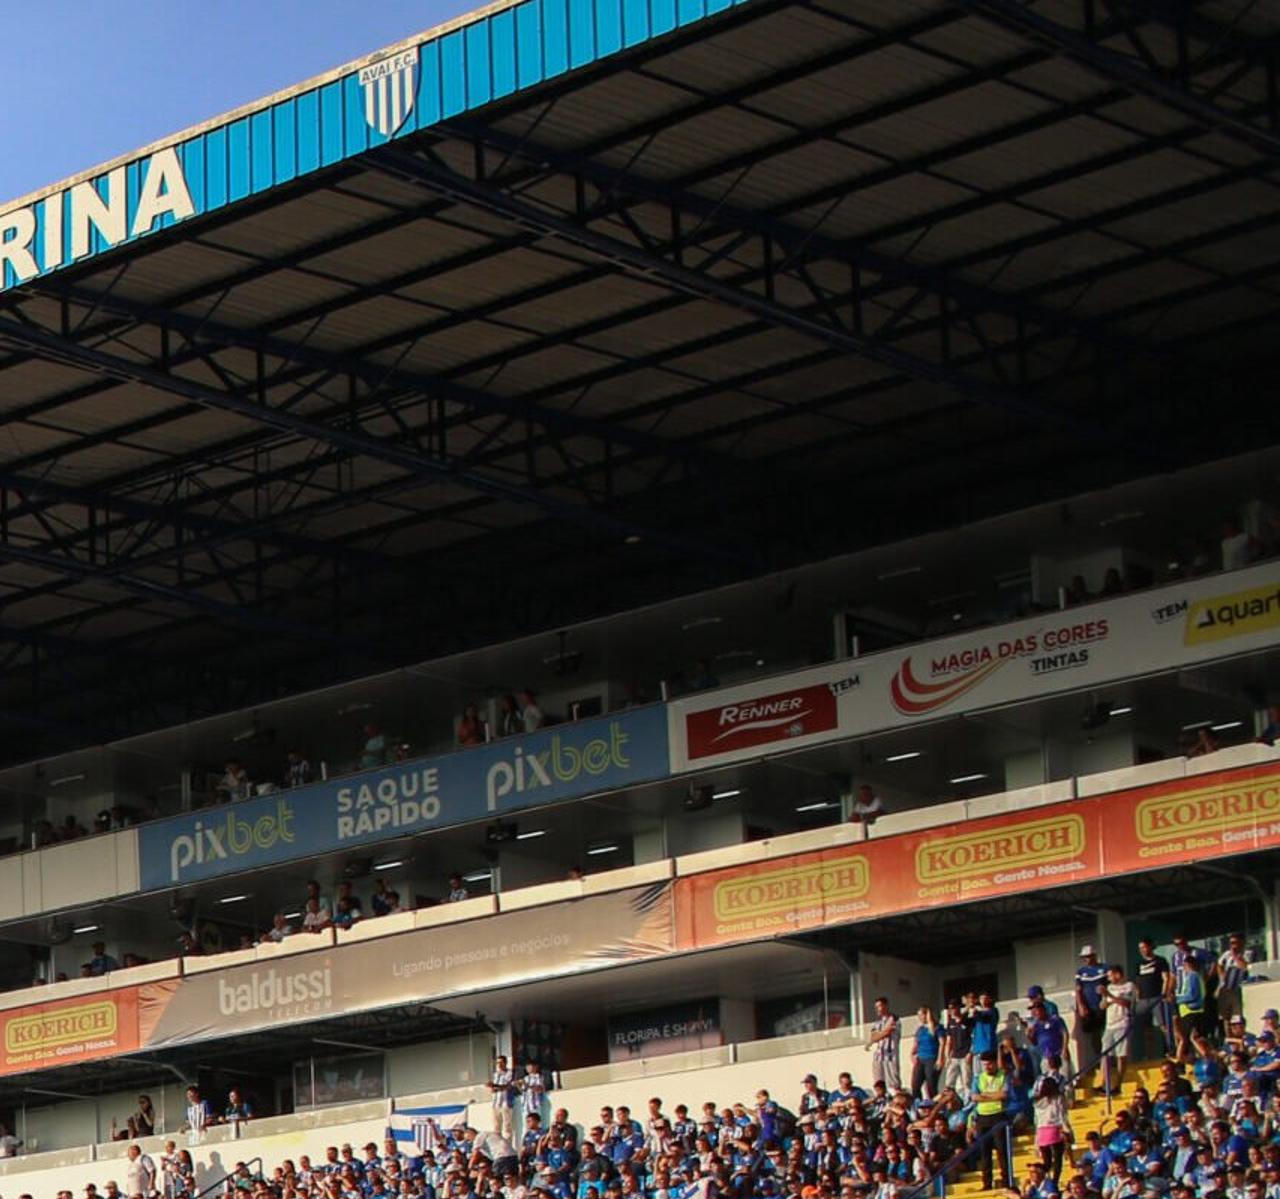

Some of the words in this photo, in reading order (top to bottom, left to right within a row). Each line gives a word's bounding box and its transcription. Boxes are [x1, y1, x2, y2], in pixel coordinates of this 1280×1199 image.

[931, 646, 992, 673] MAGIA
[998, 635, 1038, 660] DAS
[1043, 619, 1109, 648] CORES
[1031, 650, 1089, 672] TINTAS
[337, 768, 438, 812] SAQUE
[485, 722, 631, 811] pixbet
[171, 798, 295, 881] pixbet
[337, 794, 440, 839] RÁPIDO
[927, 826, 1073, 874] KOERICH
[727, 866, 858, 912] KOERICH
[218, 958, 333, 1015] baldussi
[12, 1009, 109, 1044] KOERICH
